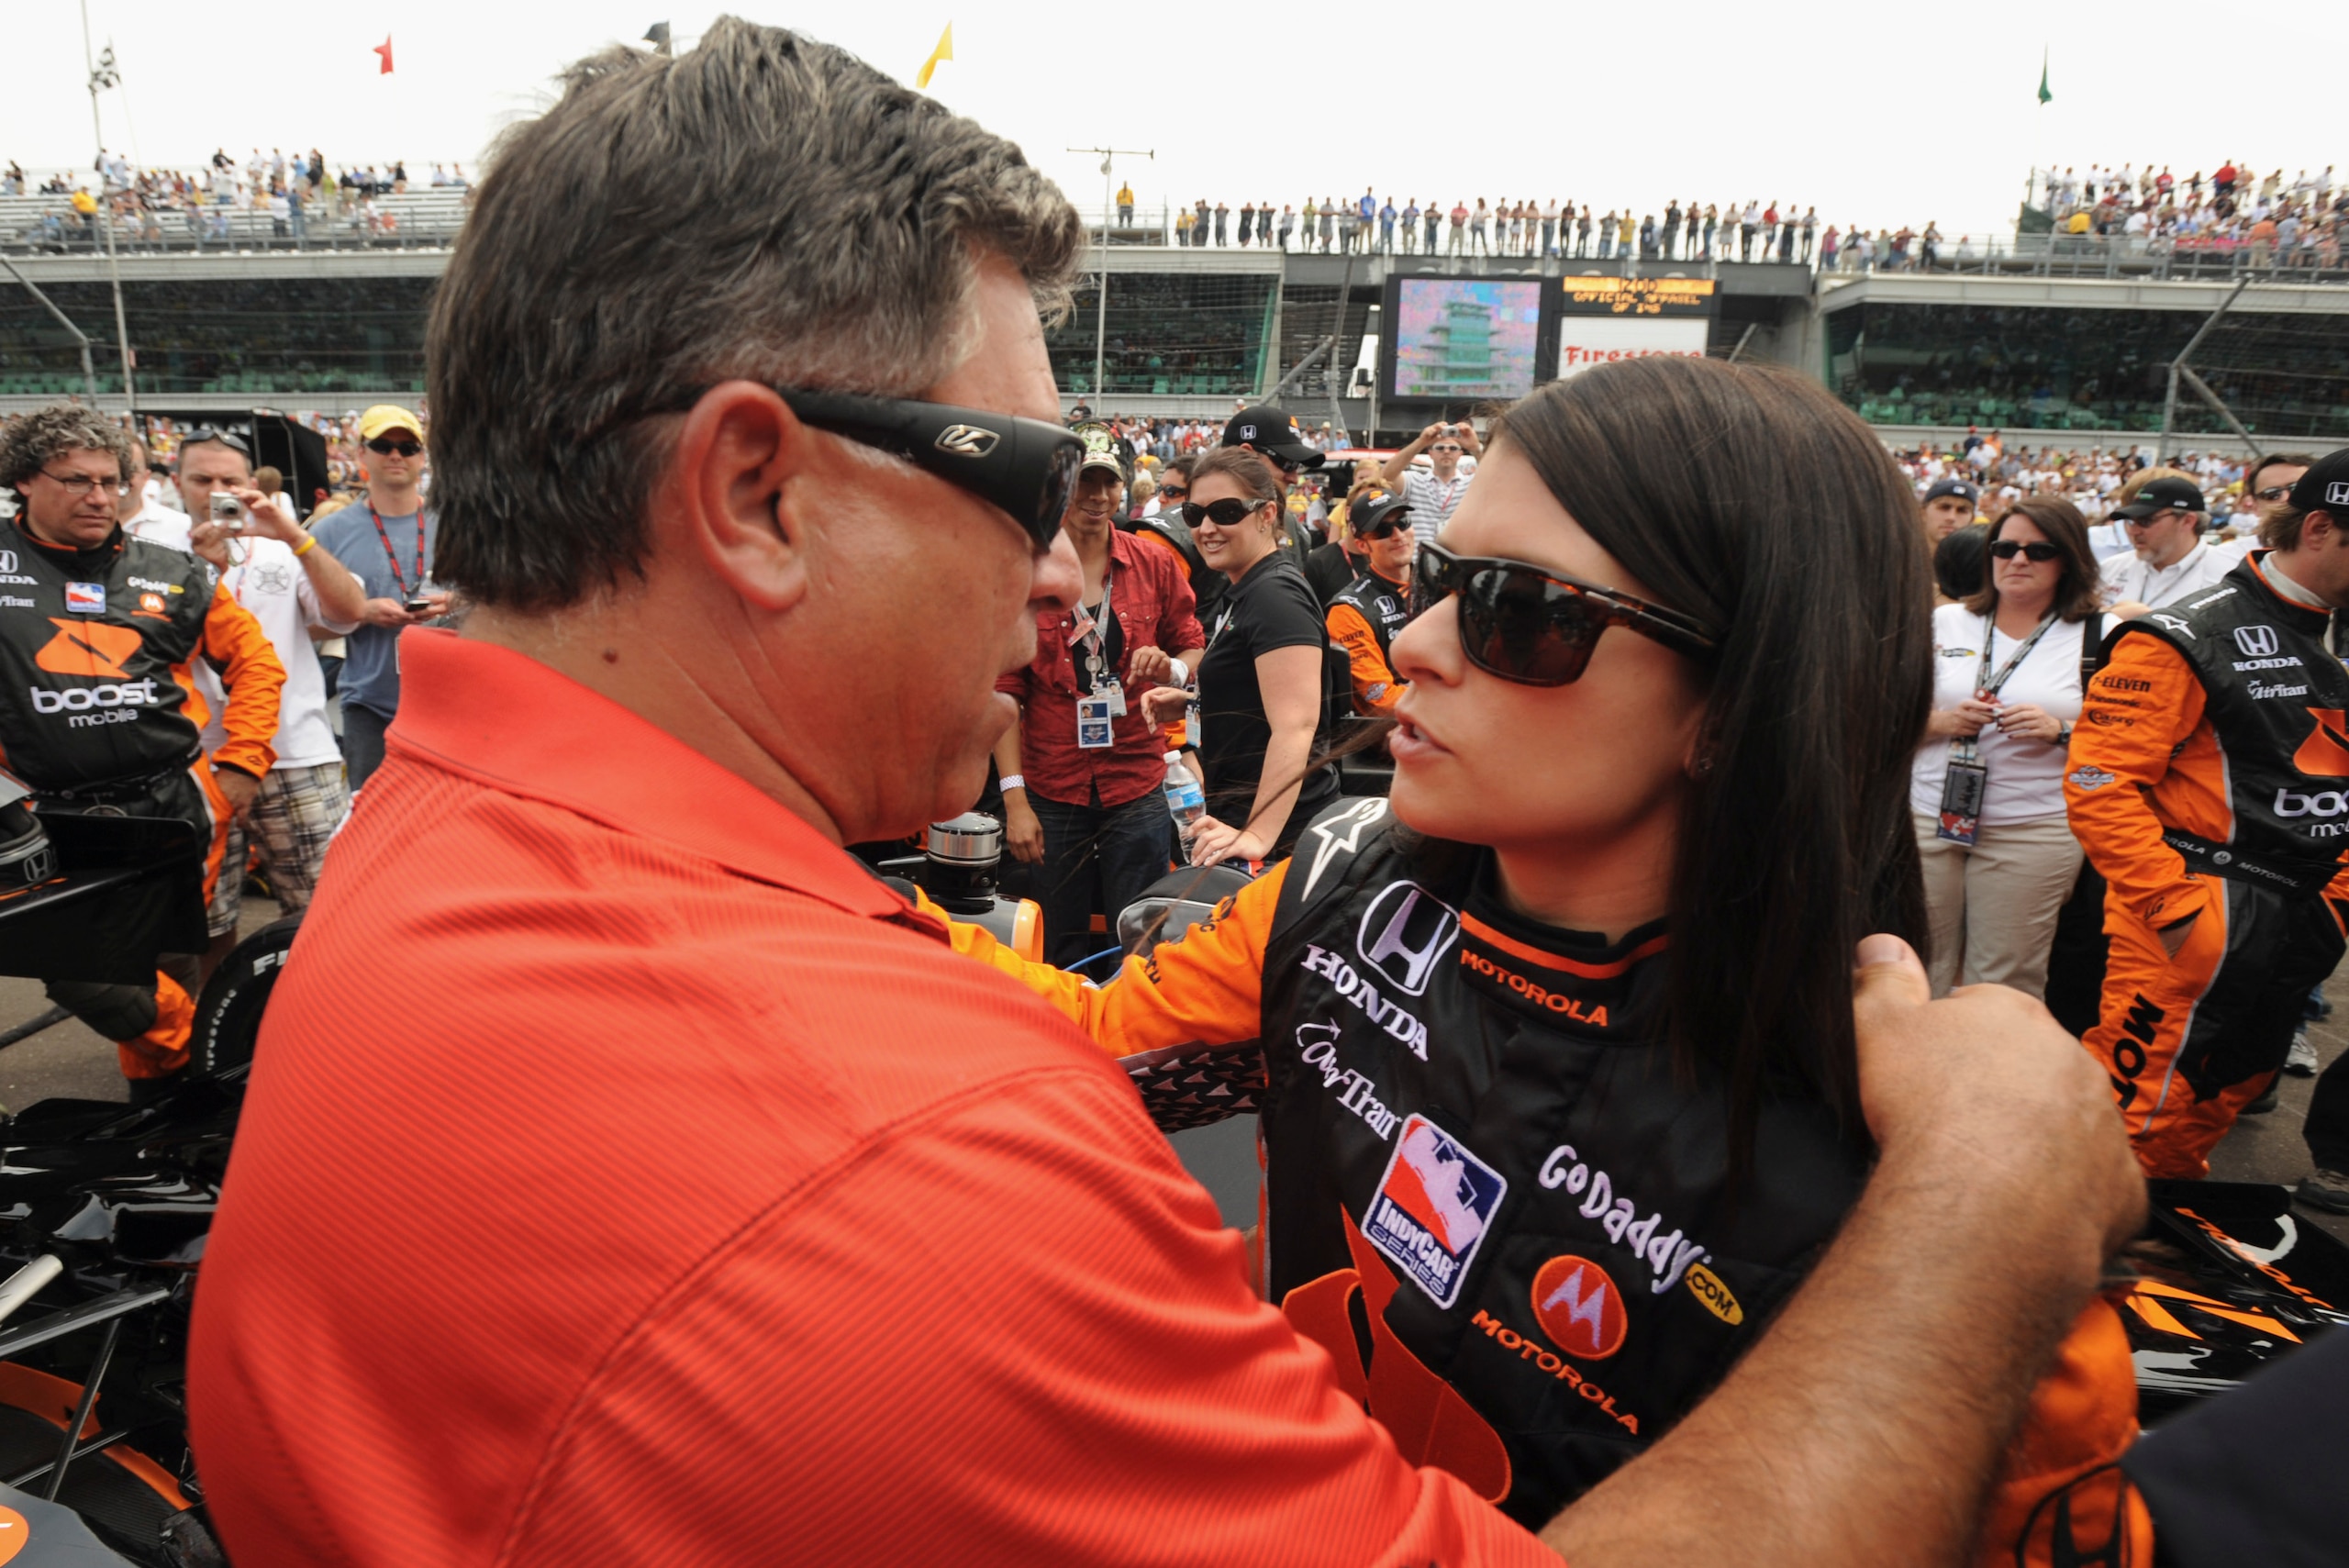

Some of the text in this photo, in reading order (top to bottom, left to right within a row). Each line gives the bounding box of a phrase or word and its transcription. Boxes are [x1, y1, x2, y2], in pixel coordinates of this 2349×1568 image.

[1611, 303, 1630, 314] OF
[2232, 656, 2303, 672] HONDA
[30, 677, 159, 714] boost
[2248, 682, 2308, 700] AirTran
[69, 708, 138, 728] mobile
[2237, 862, 2300, 888] MOTOROL
[1300, 943, 1429, 1062] HONDA
[1460, 949, 1608, 1027] MOTOROLA
[1539, 1145, 1706, 1295] GoDaddy
[1370, 1224, 1445, 1296] SERIES
[1471, 1309, 1638, 1436] MOTOROLA
